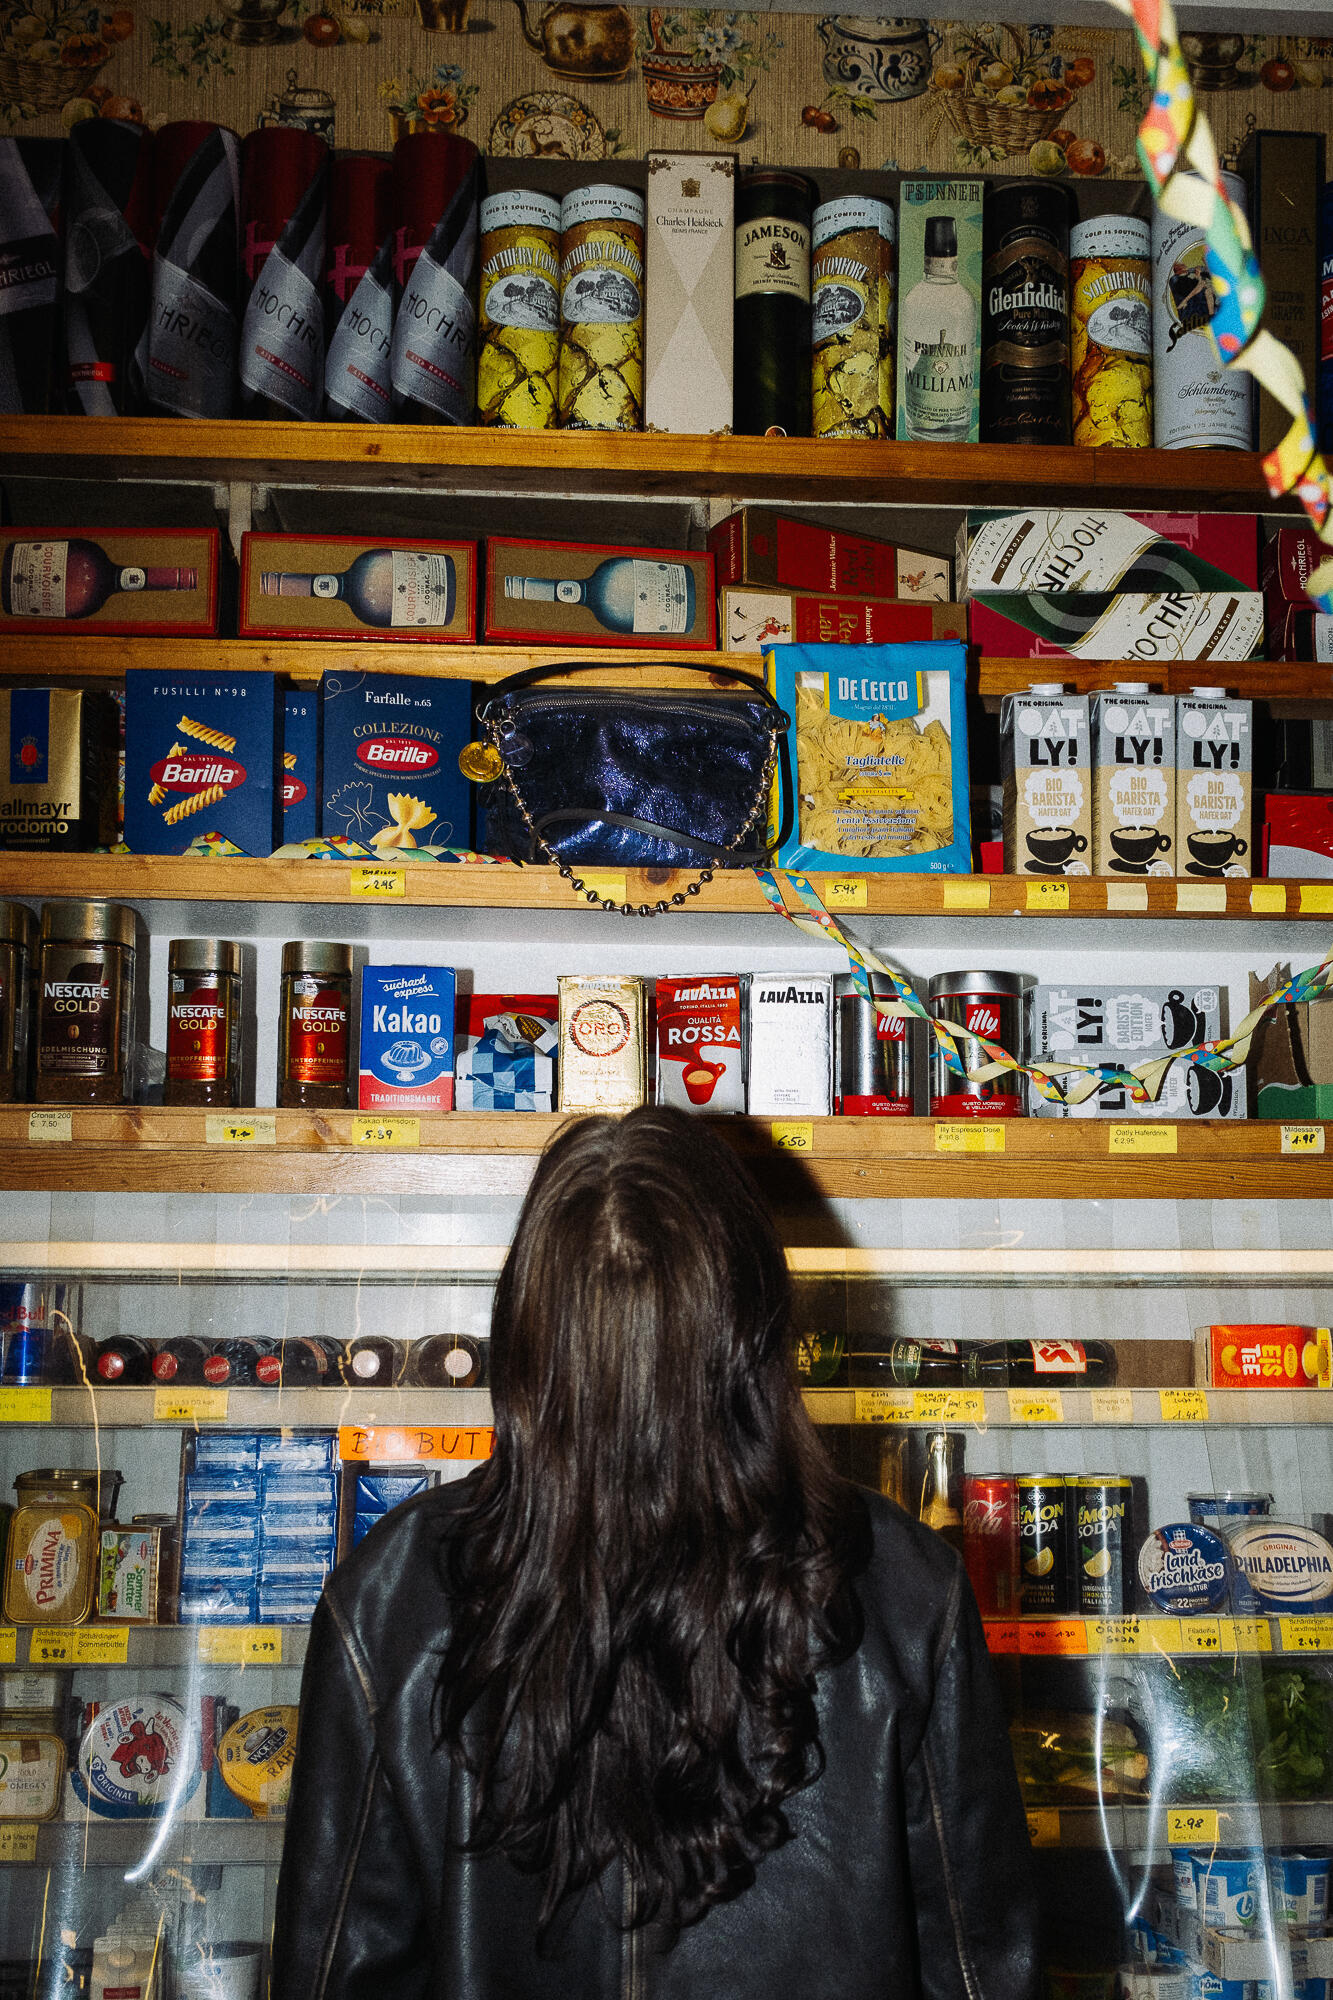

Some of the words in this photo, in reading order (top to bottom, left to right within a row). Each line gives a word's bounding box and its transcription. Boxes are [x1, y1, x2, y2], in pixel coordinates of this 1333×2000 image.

[905, 184, 981, 202] PSENNER
[511, 204, 547, 215] SOUTHERN
[581, 199, 618, 207] SOUTHERN
[667, 207, 714, 215] CHAMPAGNE
[656, 215, 686, 227] Charles
[687, 216, 724, 228] Heidsieck
[834, 210, 867, 218] COMFORT
[744, 224, 806, 249] JAMESON
[483, 246, 534, 275] SOUTHERN
[561, 242, 604, 274] SOUTHERN
[605, 240, 643, 280] COMFORT
[822, 257, 869, 282] COMFORT
[1082, 272, 1136, 304] SOUTHERN
[988, 282, 1066, 317] Glenfiddich
[998, 319, 1030, 332] Scotch
[914, 341, 967, 358] PSENNER
[905, 367, 973, 393] WILLIAMS
[1177, 381, 1247, 401] Schlumberger
[829, 534, 837, 562] Walker
[999, 534, 1024, 572] Trocken
[41, 545, 54, 612] COURVOISIER
[829, 562, 837, 592] Johnnie
[406, 556, 417, 623] COURVOISIER
[865, 604, 873, 633] Johnnie
[1206, 612, 1234, 651] Trocken
[154, 687, 207, 697] FUSILLI
[215, 687, 248, 698] N°98
[838, 677, 858, 701] DE
[861, 678, 909, 701] CECCO
[365, 690, 411, 706] Farfalle
[414, 699, 432, 707] n.65
[1119, 698, 1150, 706] ORIGINAL
[353, 722, 444, 744] COLLEZIONE
[367, 745, 429, 764] Barilla
[1029, 737, 1078, 767] LY!
[1115, 736, 1163, 765] LY!
[1193, 740, 1240, 769] LY!
[846, 754, 906, 768] Tagliatelle
[162, 763, 235, 784] Barilla
[1045, 778, 1063, 792] BIO
[1130, 776, 1147, 791] BIO
[1207, 781, 1224, 795] BIO
[1032, 791, 1077, 807] BARISTA
[1116, 791, 1161, 807] BARISTA
[1193, 795, 1238, 811] BARISTA
[1, 798, 71, 819] allmayr
[1038, 808, 1058, 818] HAFER
[1058, 808, 1071, 818] OAT
[1122, 807, 1143, 817] HAFER
[1143, 807, 1156, 817] OAT
[1199, 811, 1219, 821] HAFER
[1220, 811, 1233, 821] OAT
[0, 820, 69, 836] rodomo
[836, 816, 860, 825] Lenta
[930, 861, 941, 870] 500
[942, 863, 947, 872] g
[1041, 884, 1066, 893] 6.29
[44, 979, 111, 1000] NESCAFÉ
[382, 974, 427, 993] suchard
[393, 983, 434, 1000] express
[578, 983, 621, 991] LAVAZZA
[673, 984, 737, 1003] LAVAZZA
[758, 986, 825, 1005] LAVAZZA
[53, 1000, 101, 1014] GOLD
[171, 1002, 225, 1019] NESCAFÉ
[292, 1004, 347, 1022] NESCAFÉ
[179, 1019, 218, 1031] GOLD
[302, 1021, 340, 1033] GOLD
[373, 1004, 442, 1034] Kakao
[687, 1014, 722, 1025] QUALITÀ
[878, 1015, 905, 1038] illy
[968, 1009, 998, 1036] illy
[1076, 997, 1104, 1044] LY!
[1116, 1000, 1130, 1044] BARISTA
[1131, 1002, 1144, 1042] EDITION
[578, 1021, 620, 1036] ORO
[668, 1025, 741, 1046] ROSSA
[41, 1046, 108, 1055] EDELMISCHUNG
[1170, 1076, 1178, 1097] HAFER
[370, 1093, 441, 1104] TRADITIONSMARKE
[31, 1111, 57, 1119] Cronat
[41, 1120, 58, 1128] 7.50
[365, 1129, 393, 1140] 5.39
[777, 1135, 807, 1147] 6.50
[1115, 1129, 1133, 1138] Oatly
[1120, 1137, 1135, 1145] 2.95
[17, 1306, 45, 1321] Bull
[1241, 1344, 1261, 1376] TEE
[1078, 1519, 1118, 1539] SODA
[1263, 1543, 1298, 1551] ORIGINAL
[35, 1529, 62, 1606] PRIMINA
[1166, 1550, 1199, 1573] Land
[1234, 1556, 1332, 1574] PHILADELPHIA
[1149, 1564, 1223, 1590] frischkäse
[125, 1571, 134, 1608] Butter
[134, 1566, 146, 1613] Sommer
[1188, 1583, 1209, 1593] NATUR
[78, 1640, 126, 1649] Sommerbutter
[79, 1632, 119, 1641] Schärdinger
[249, 1729, 286, 1762] WOERLE
[96, 1773, 132, 1801] ORIGINAL
[1174, 1817, 1205, 1830] 2.98
[14, 1833, 35, 1841] Vache
